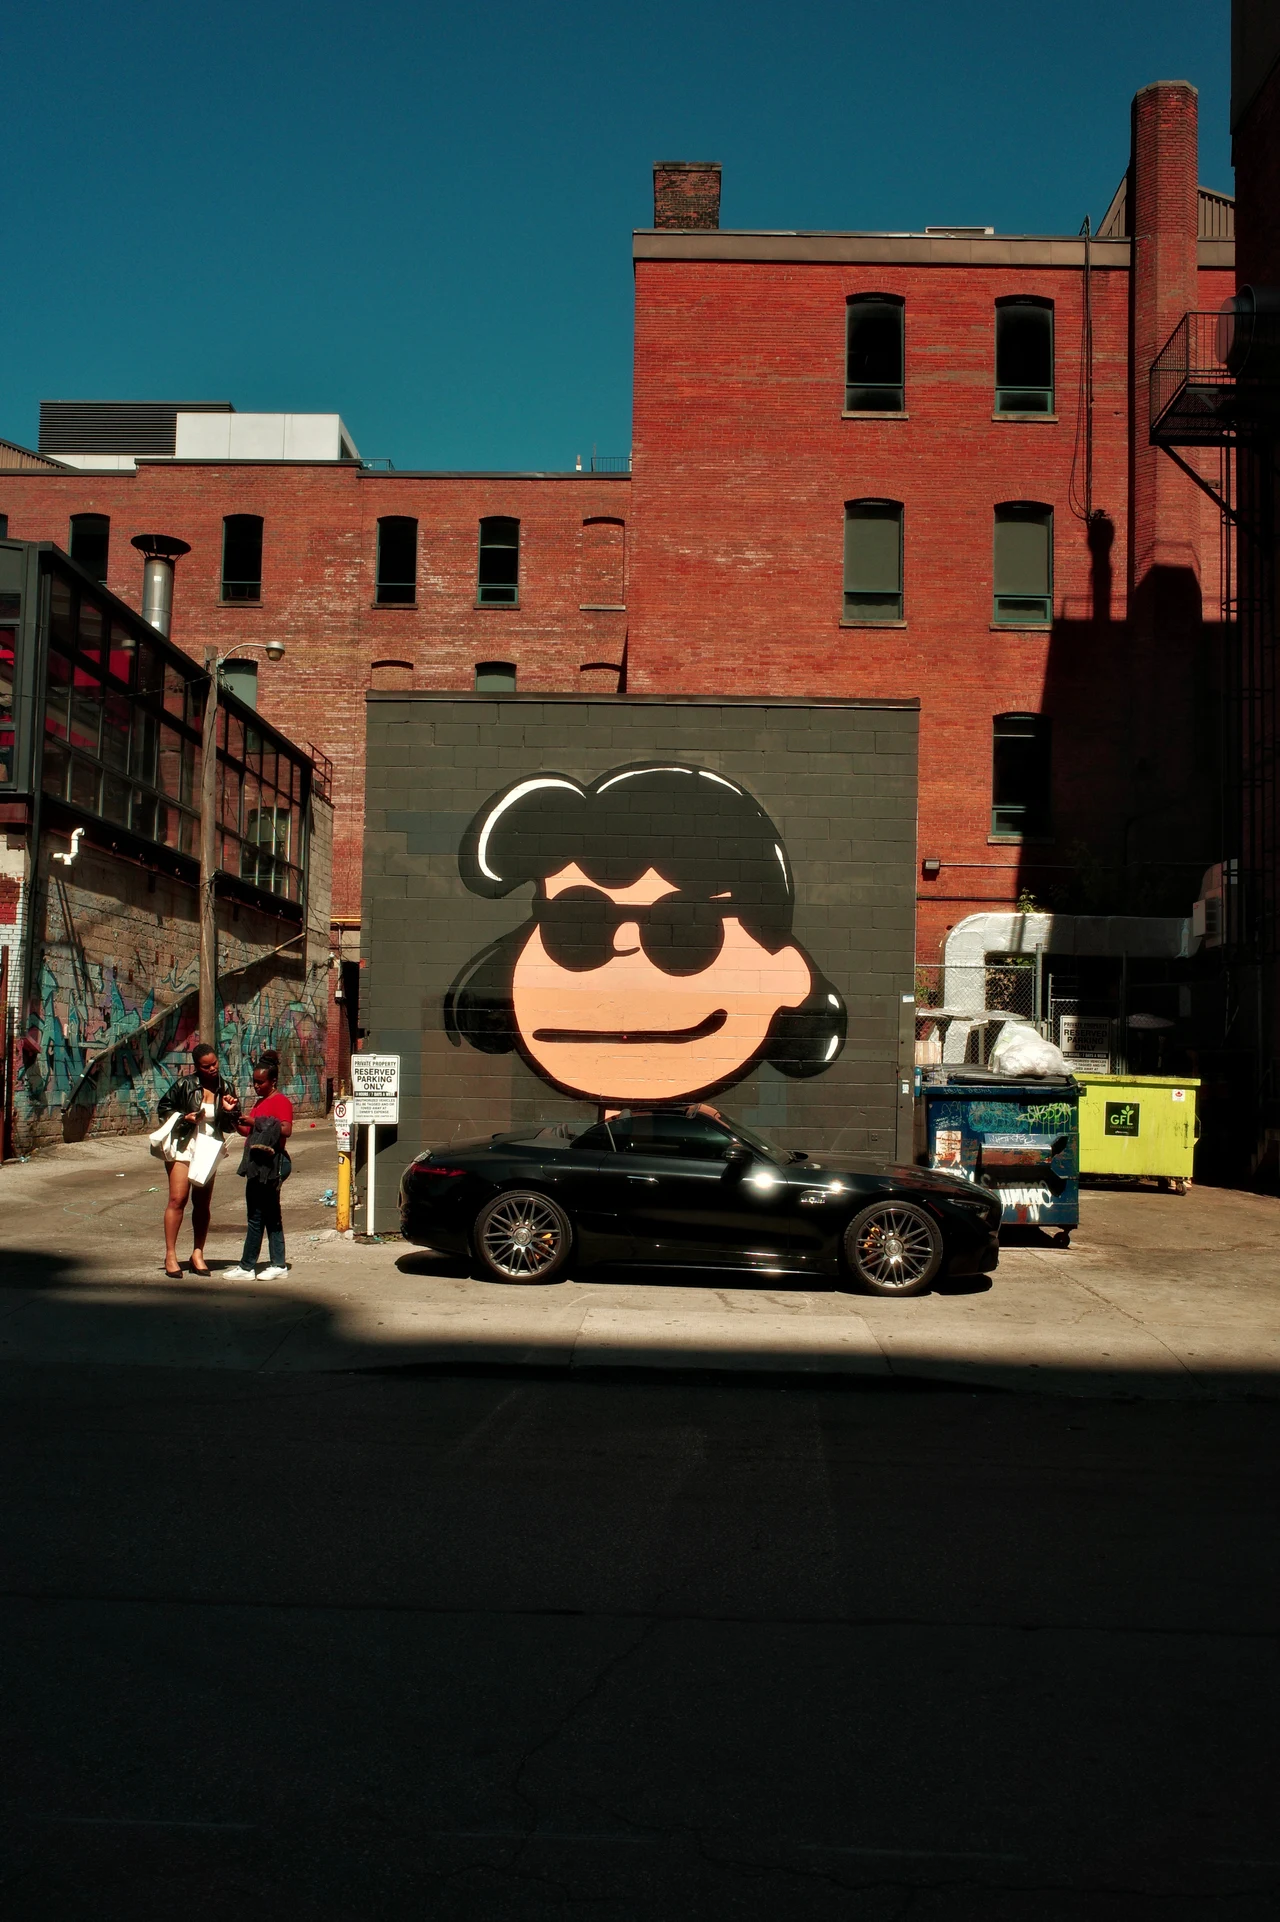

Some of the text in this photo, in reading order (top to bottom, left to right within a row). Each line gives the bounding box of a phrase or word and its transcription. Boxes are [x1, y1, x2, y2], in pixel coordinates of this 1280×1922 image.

[1064, 1029, 1107, 1037] RESERVED
[355, 1068, 396, 1076] RESERVED
[1110, 1110, 1134, 1126] GFL
